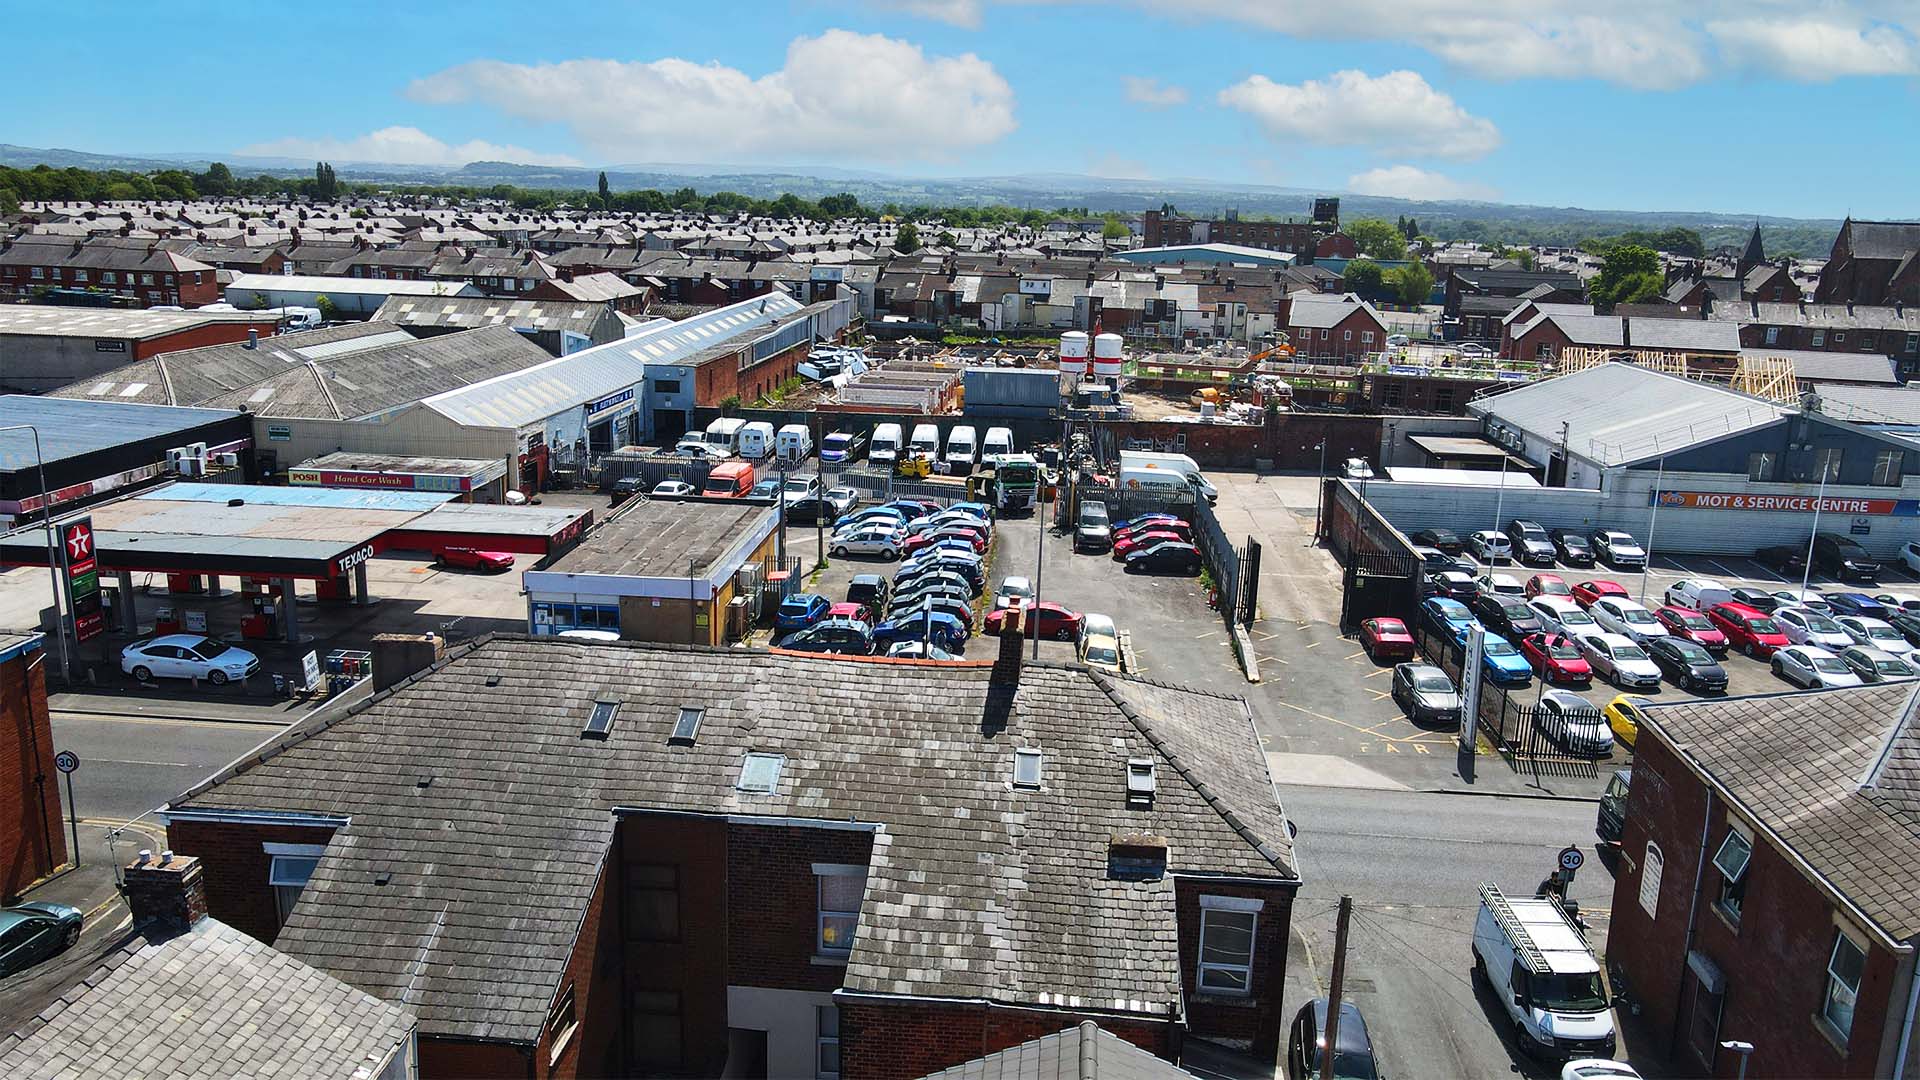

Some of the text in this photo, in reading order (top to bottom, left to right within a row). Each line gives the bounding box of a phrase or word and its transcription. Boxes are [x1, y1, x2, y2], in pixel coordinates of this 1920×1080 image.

[292, 473, 318, 482] POSH
[334, 474, 402, 485] Hand Car Wash
[1696, 495, 1869, 512] MOT & SERVICE CENTRE
[338, 545, 374, 571] TEXACO
[57, 757, 73, 767] 30
[1563, 855, 1581, 865] 30
